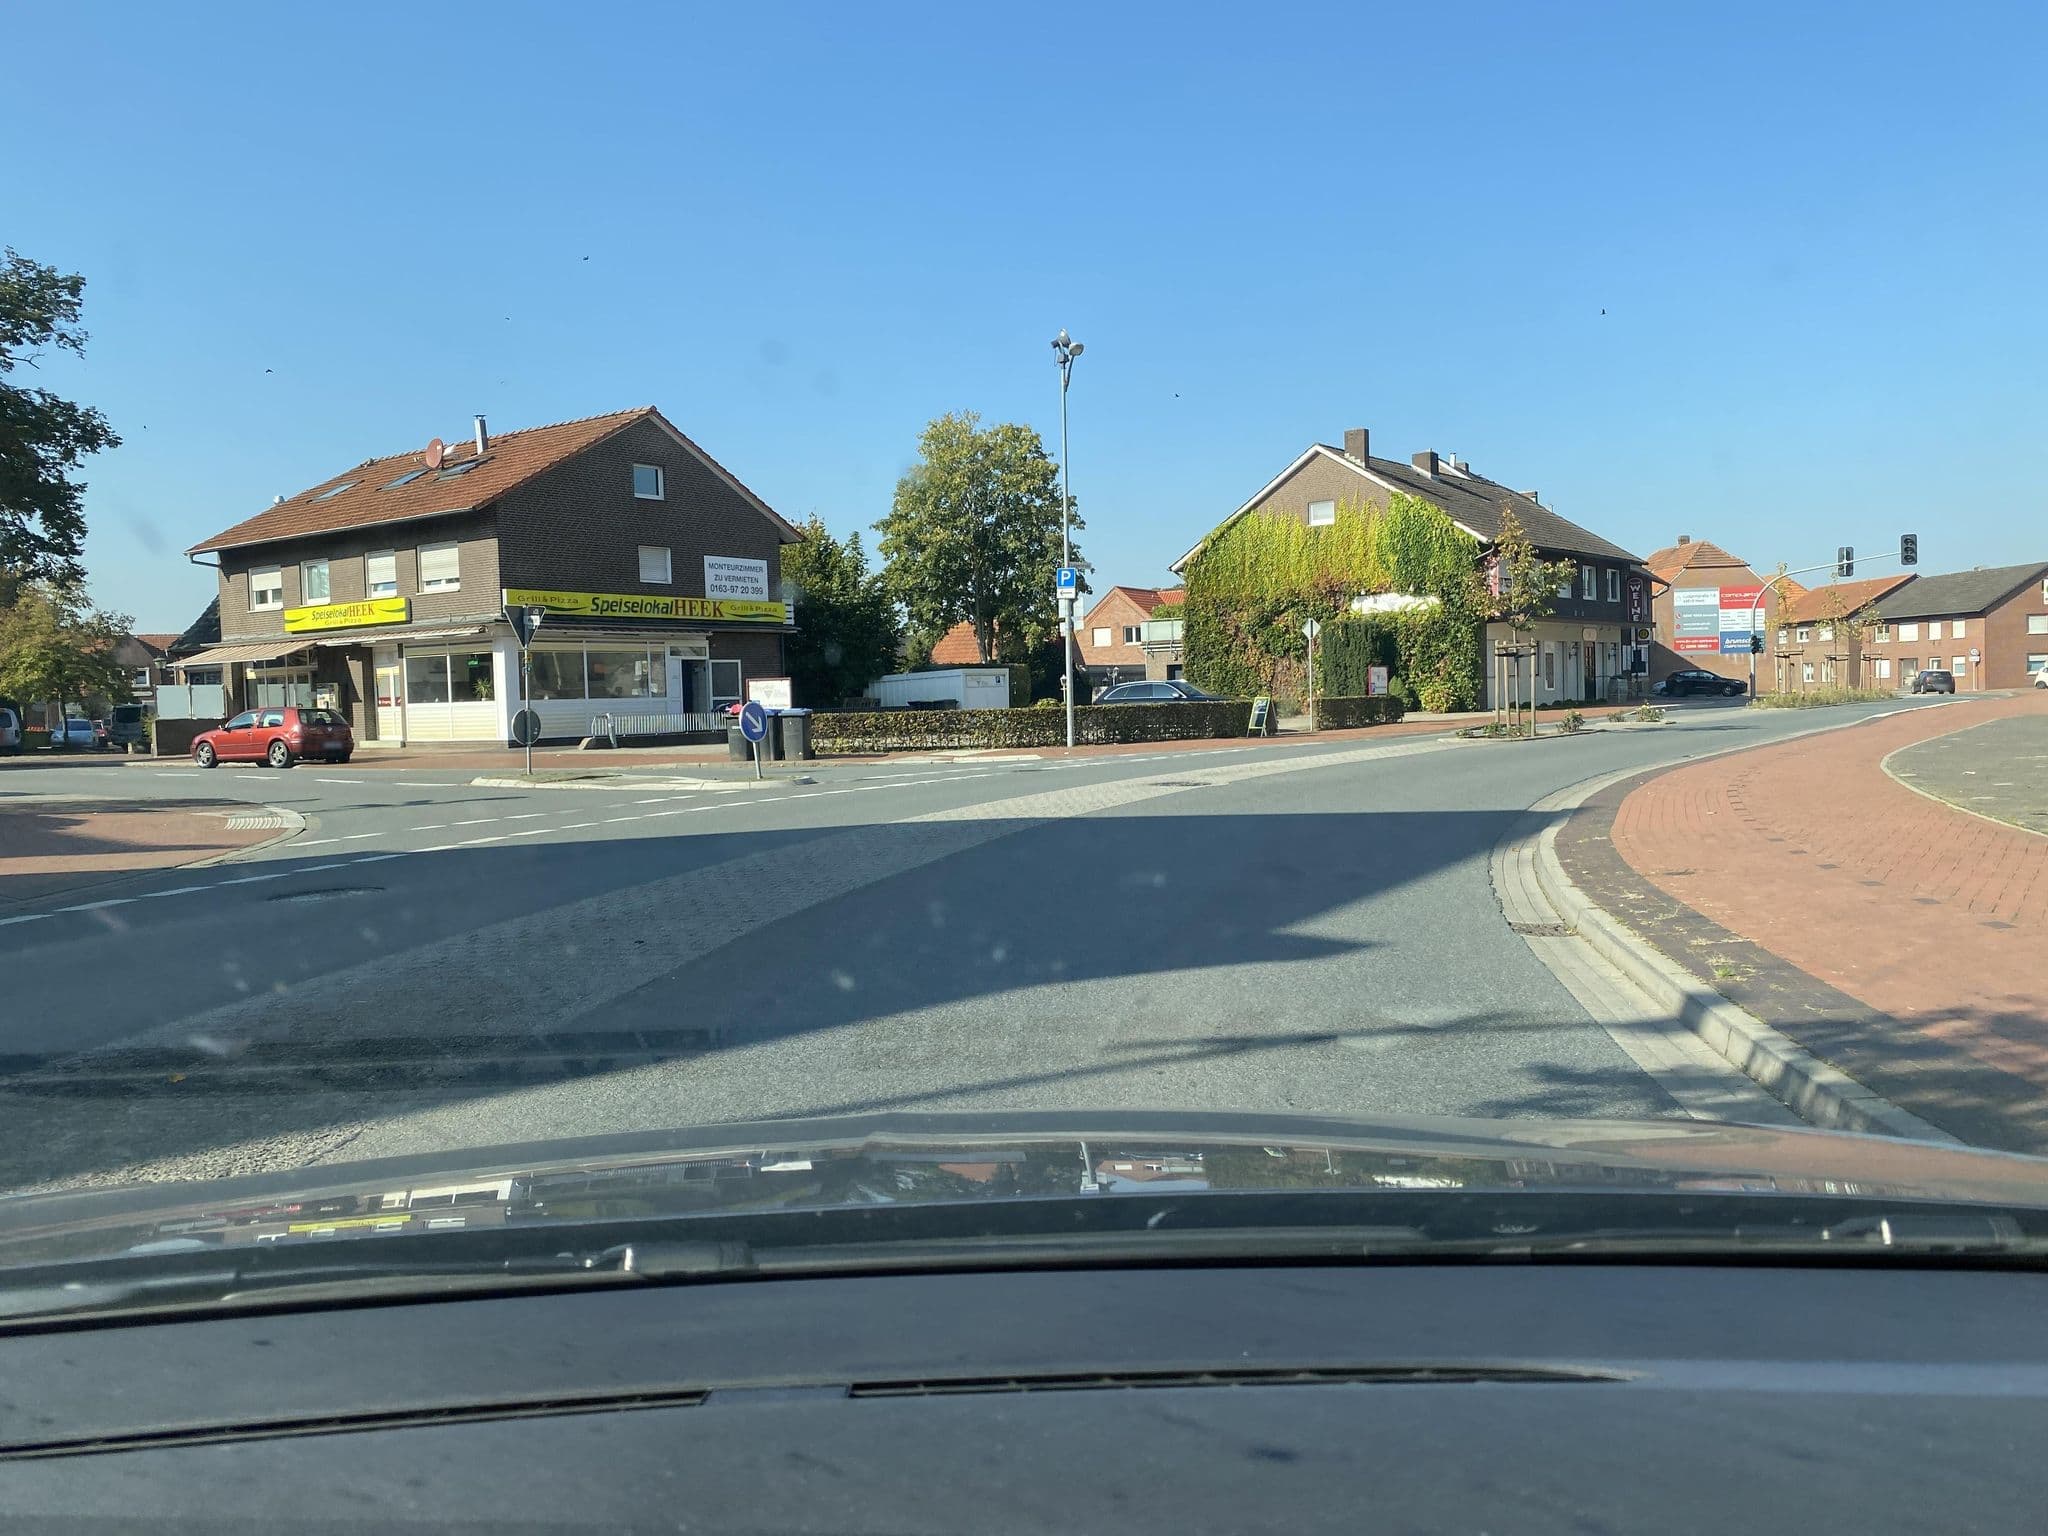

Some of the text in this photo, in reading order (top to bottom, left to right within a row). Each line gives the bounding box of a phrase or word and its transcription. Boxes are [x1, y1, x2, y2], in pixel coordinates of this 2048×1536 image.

[708, 562, 764, 573] MONTEURZIMMER
[714, 574, 759, 584] ZU VERMIETEN
[1061, 570, 1071, 586] P
[710, 584, 764, 595] 0163-97 20 399
[1630, 585, 1641, 622] WEINE
